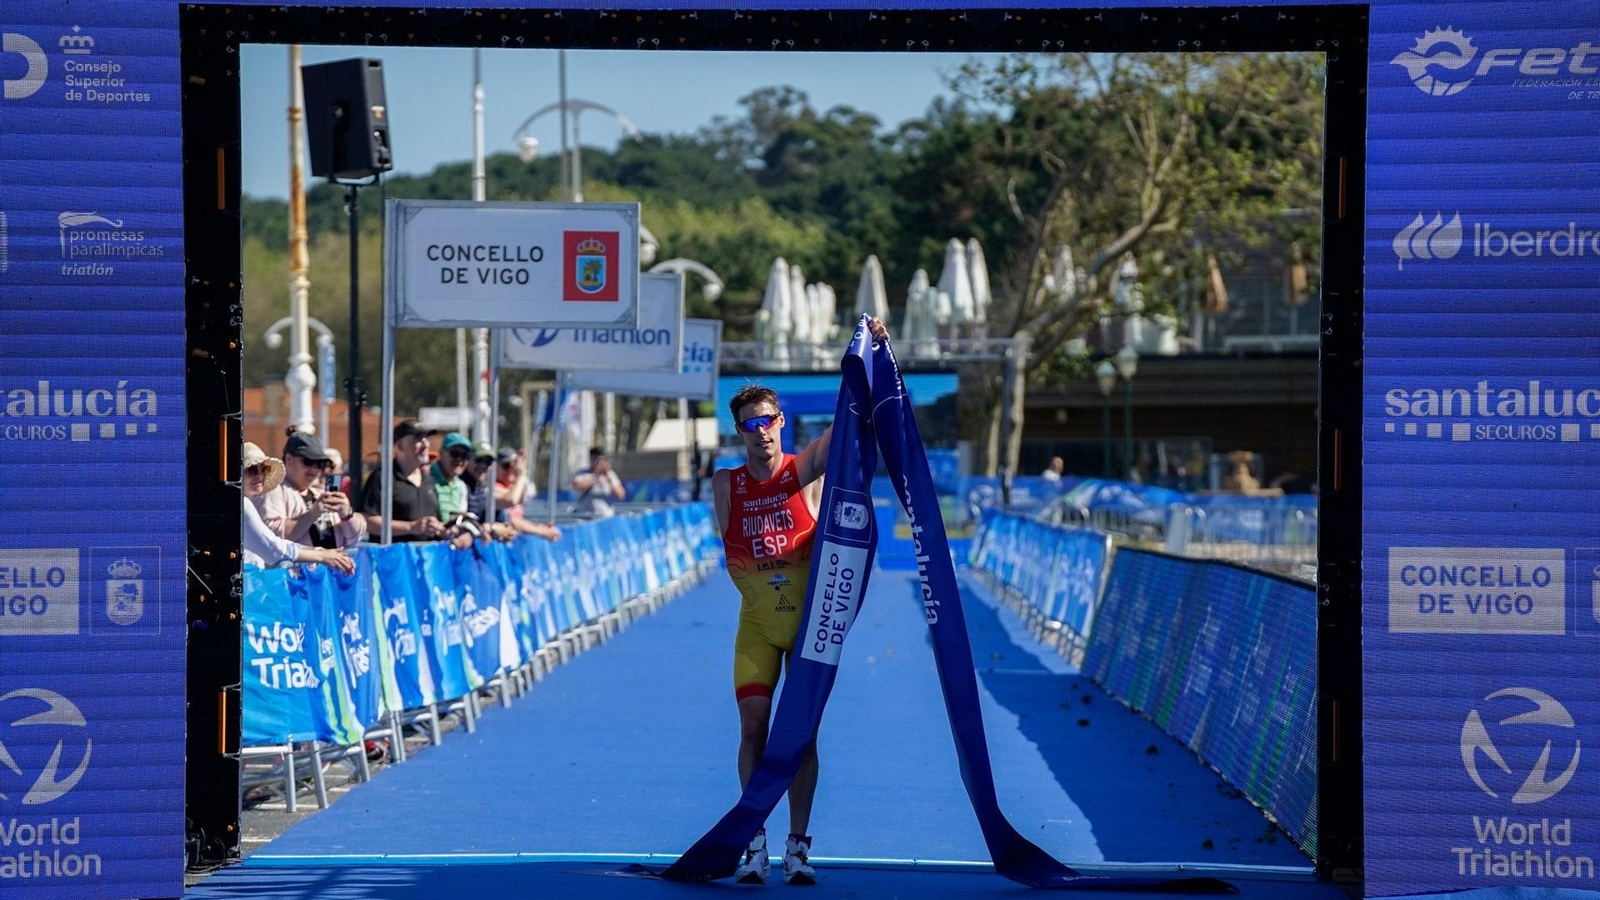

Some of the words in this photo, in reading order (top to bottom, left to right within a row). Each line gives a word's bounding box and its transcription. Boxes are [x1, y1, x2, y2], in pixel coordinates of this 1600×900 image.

[64, 60, 122, 75] Consejo
[65, 75, 126, 88] Superior
[65, 89, 83, 101] de
[86, 90, 150, 104] Deportes
[1568, 91, 1584, 100] DE
[70, 227, 144, 246] promesas
[1474, 221, 1600, 257] Iberdr
[71, 242, 164, 260] paralímpicas
[426, 244, 544, 262] CONCELLO
[61, 260, 114, 276] triatlón
[440, 268, 468, 284] DE
[476, 268, 530, 285] VIGO
[0, 380, 157, 418] alucía
[1476, 424, 1556, 441] SEGUROS
[742, 508, 794, 538] RIUDAVETS
[752, 534, 788, 560] ESP
[1400, 565, 1552, 588] CONCELLO
[835, 567, 856, 617] VIGO
[814, 552, 840, 655] CONCELLO
[1418, 593, 1455, 614] DE
[1465, 593, 1534, 615] VIGO
[830, 617, 845, 647] DE
[1472, 815, 1572, 847] World
[1450, 847, 1595, 879] Triathlon
